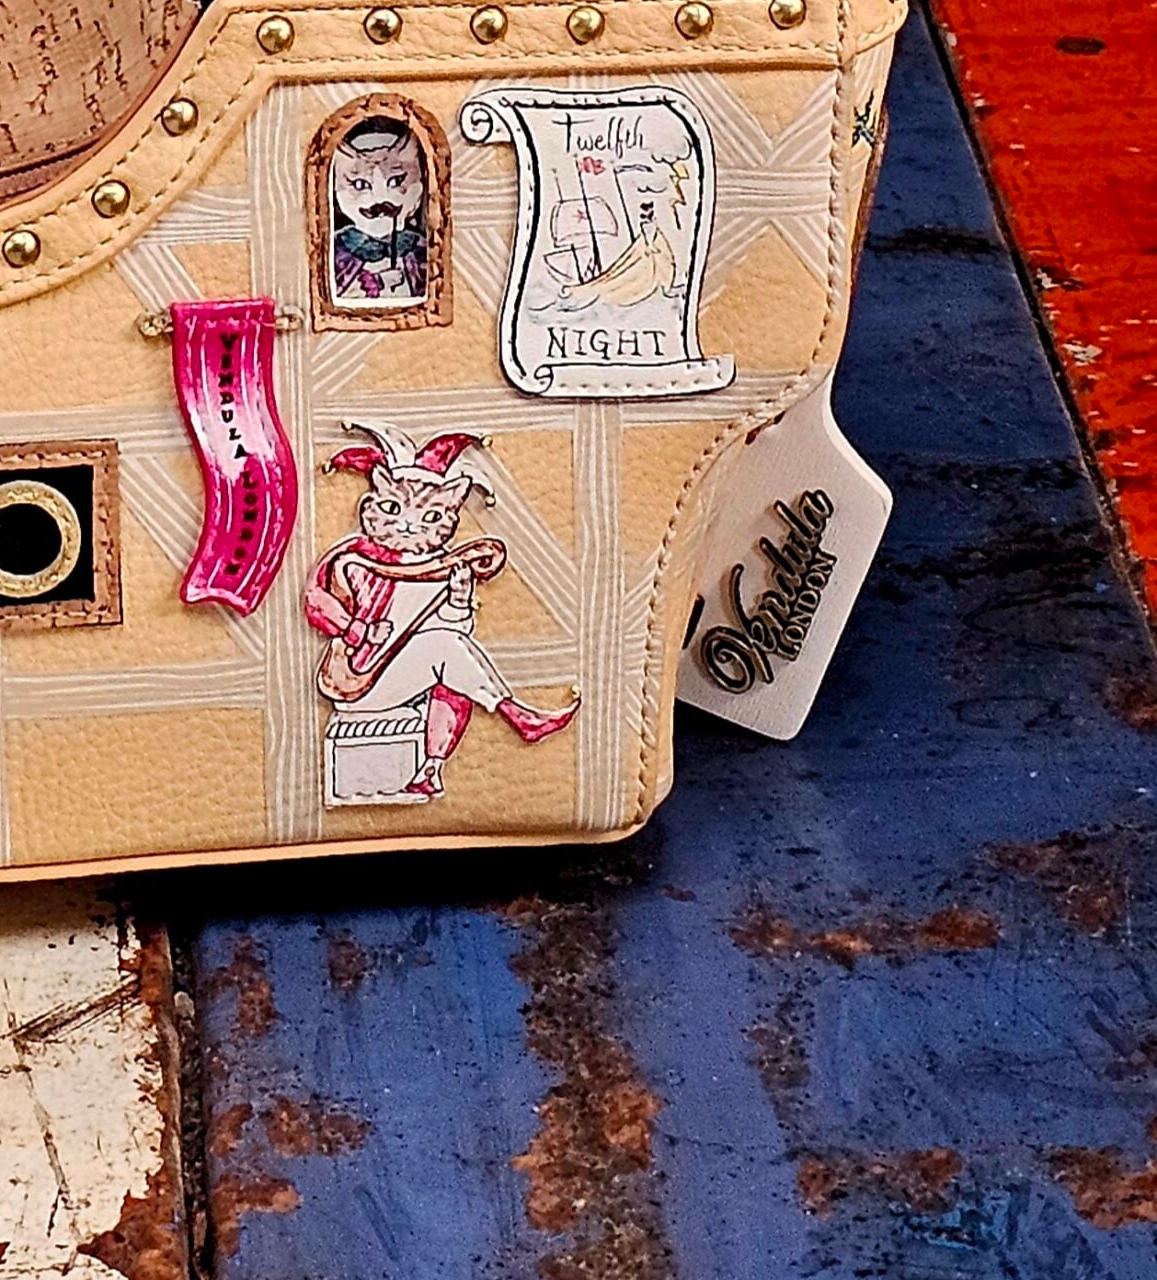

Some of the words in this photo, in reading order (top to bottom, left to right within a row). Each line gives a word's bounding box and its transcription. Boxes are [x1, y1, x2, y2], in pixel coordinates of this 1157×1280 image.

[552, 112, 645, 158] Twelfth
[546, 326, 667, 361] NIGHT
[777, 550, 838, 662] LONDON
